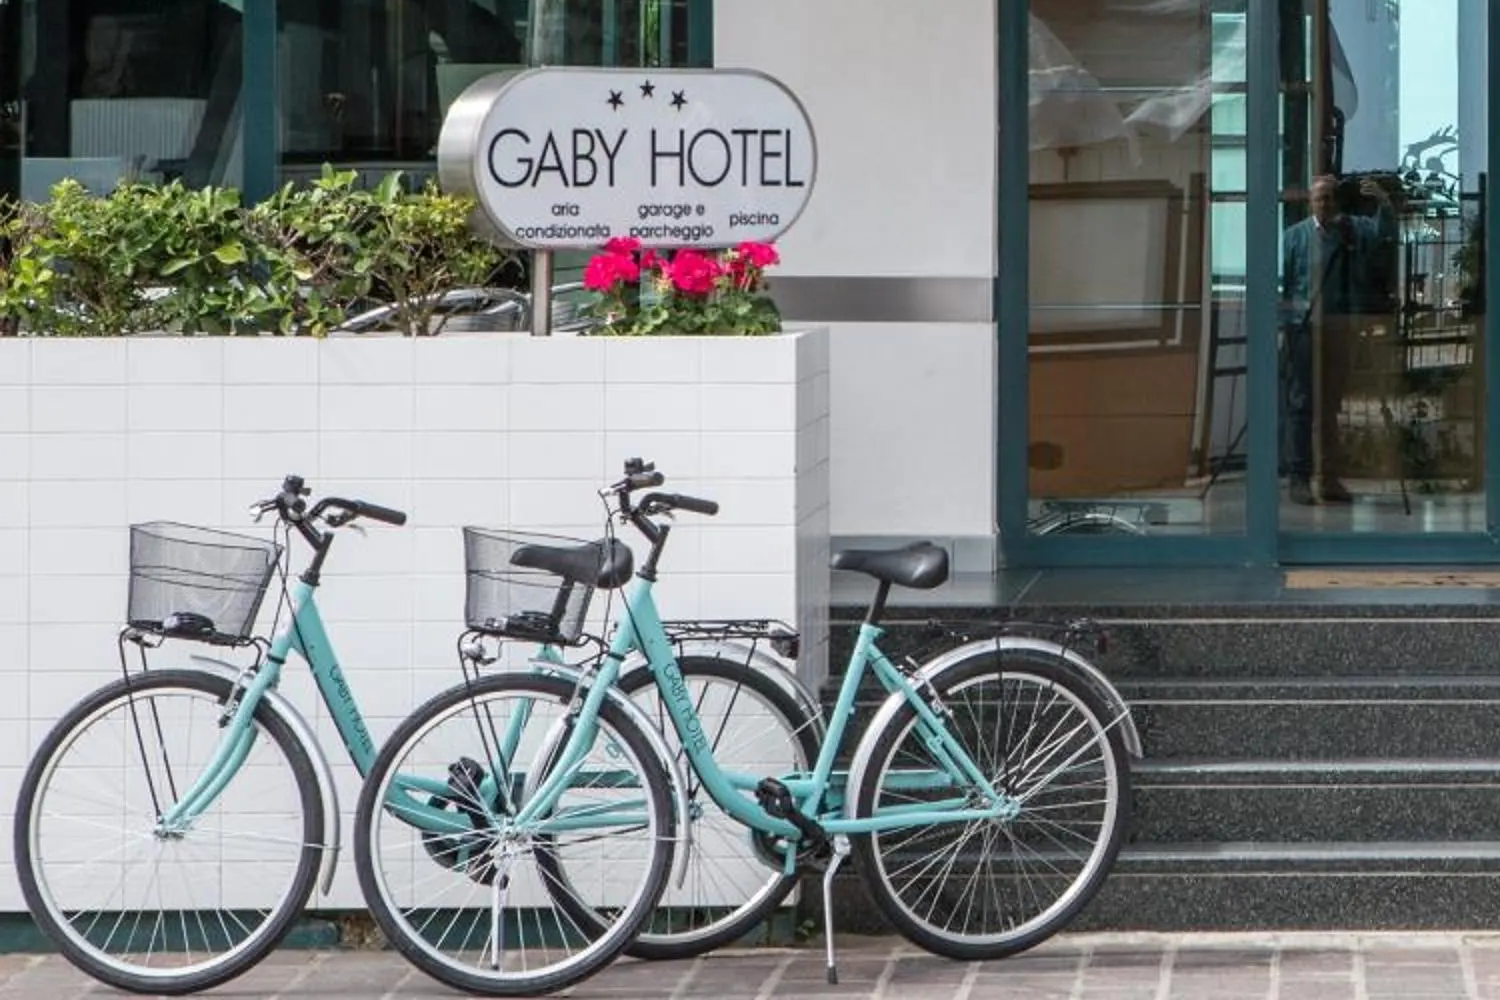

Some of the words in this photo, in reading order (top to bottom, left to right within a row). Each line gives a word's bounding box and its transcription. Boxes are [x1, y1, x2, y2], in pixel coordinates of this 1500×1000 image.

[487, 128, 628, 188] GABY
[650, 128, 805, 188] HOTEL
[551, 202, 580, 217] aria
[638, 203, 692, 220] garage
[695, 203, 705, 217] e
[729, 210, 780, 229] piscina
[515, 223, 611, 239] condizionata
[629, 223, 714, 241] parcheggio
[664, 662, 688, 703] GABY
